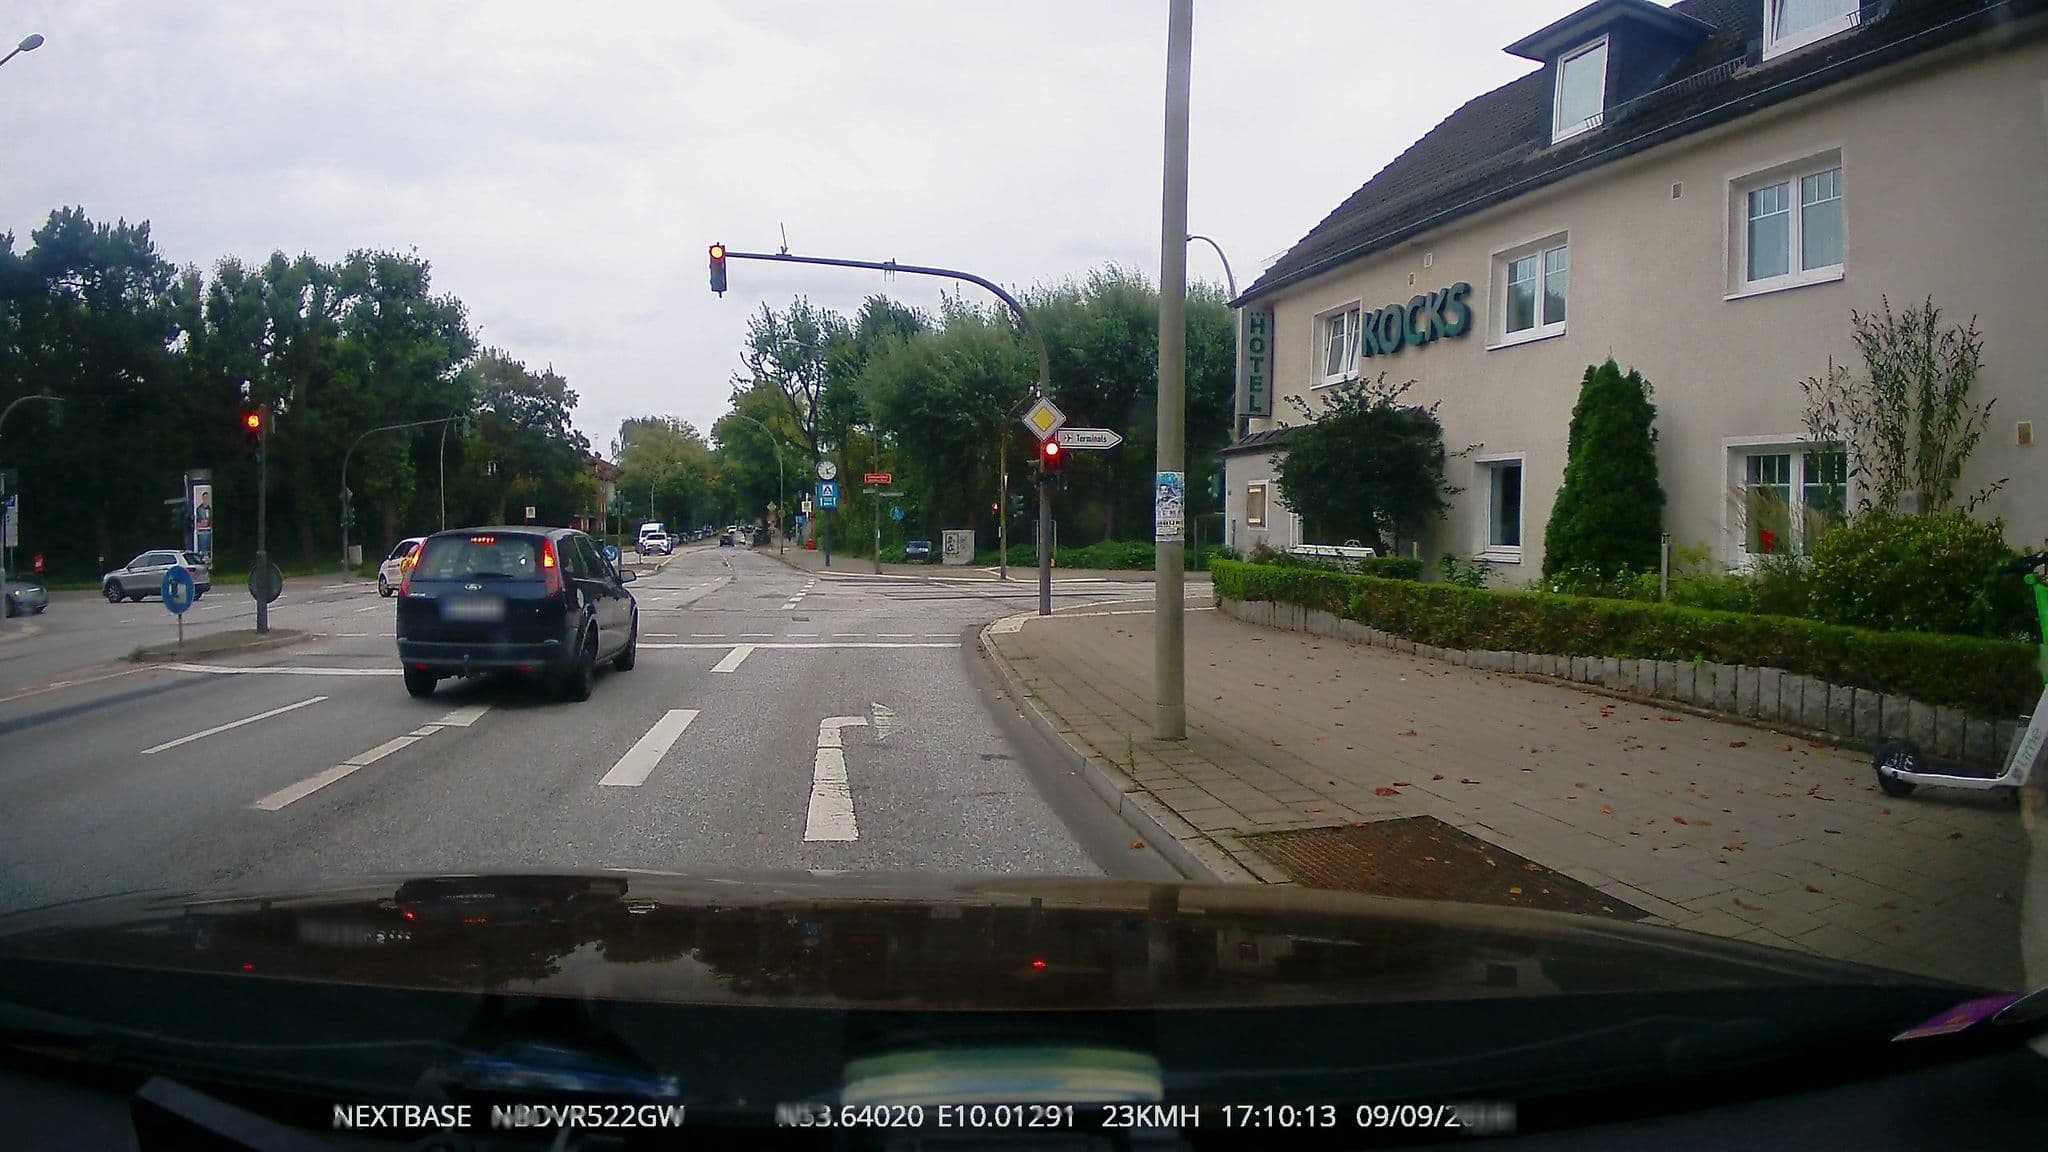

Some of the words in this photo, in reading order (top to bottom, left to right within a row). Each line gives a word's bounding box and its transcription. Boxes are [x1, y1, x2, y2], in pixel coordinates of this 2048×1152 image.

[1362, 281, 1474, 357] KOCKS
[1249, 318, 1265, 413] HOTEL
[1076, 434, 1107, 443] Terminals
